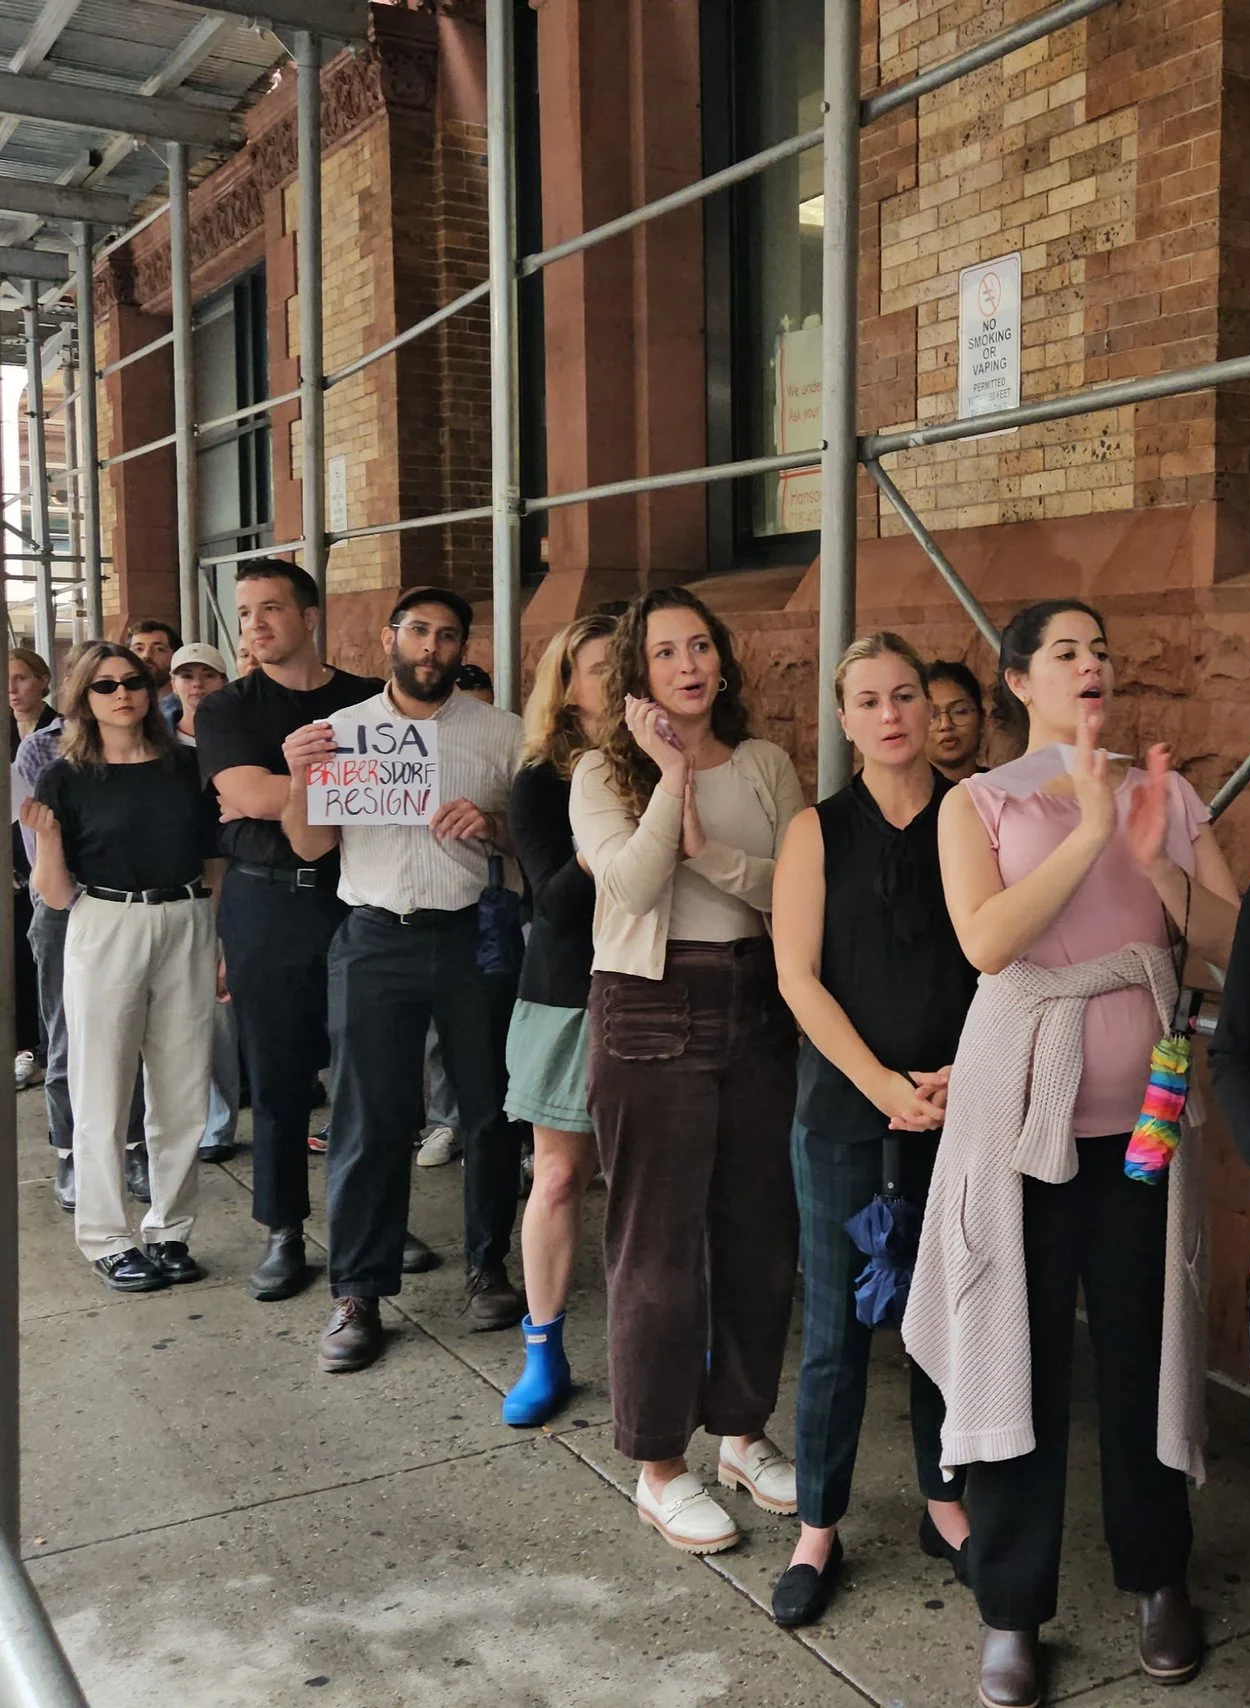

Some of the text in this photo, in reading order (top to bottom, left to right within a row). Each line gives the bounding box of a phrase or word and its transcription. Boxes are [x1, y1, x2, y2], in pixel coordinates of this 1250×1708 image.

[983, 318, 996, 331] NO
[968, 328, 1011, 350] SMOKING
[983, 346, 996, 359] OR
[973, 357, 1006, 376] VAPING
[974, 377, 1005, 392] PERMITTED
[791, 490, 821, 506] Hanso
